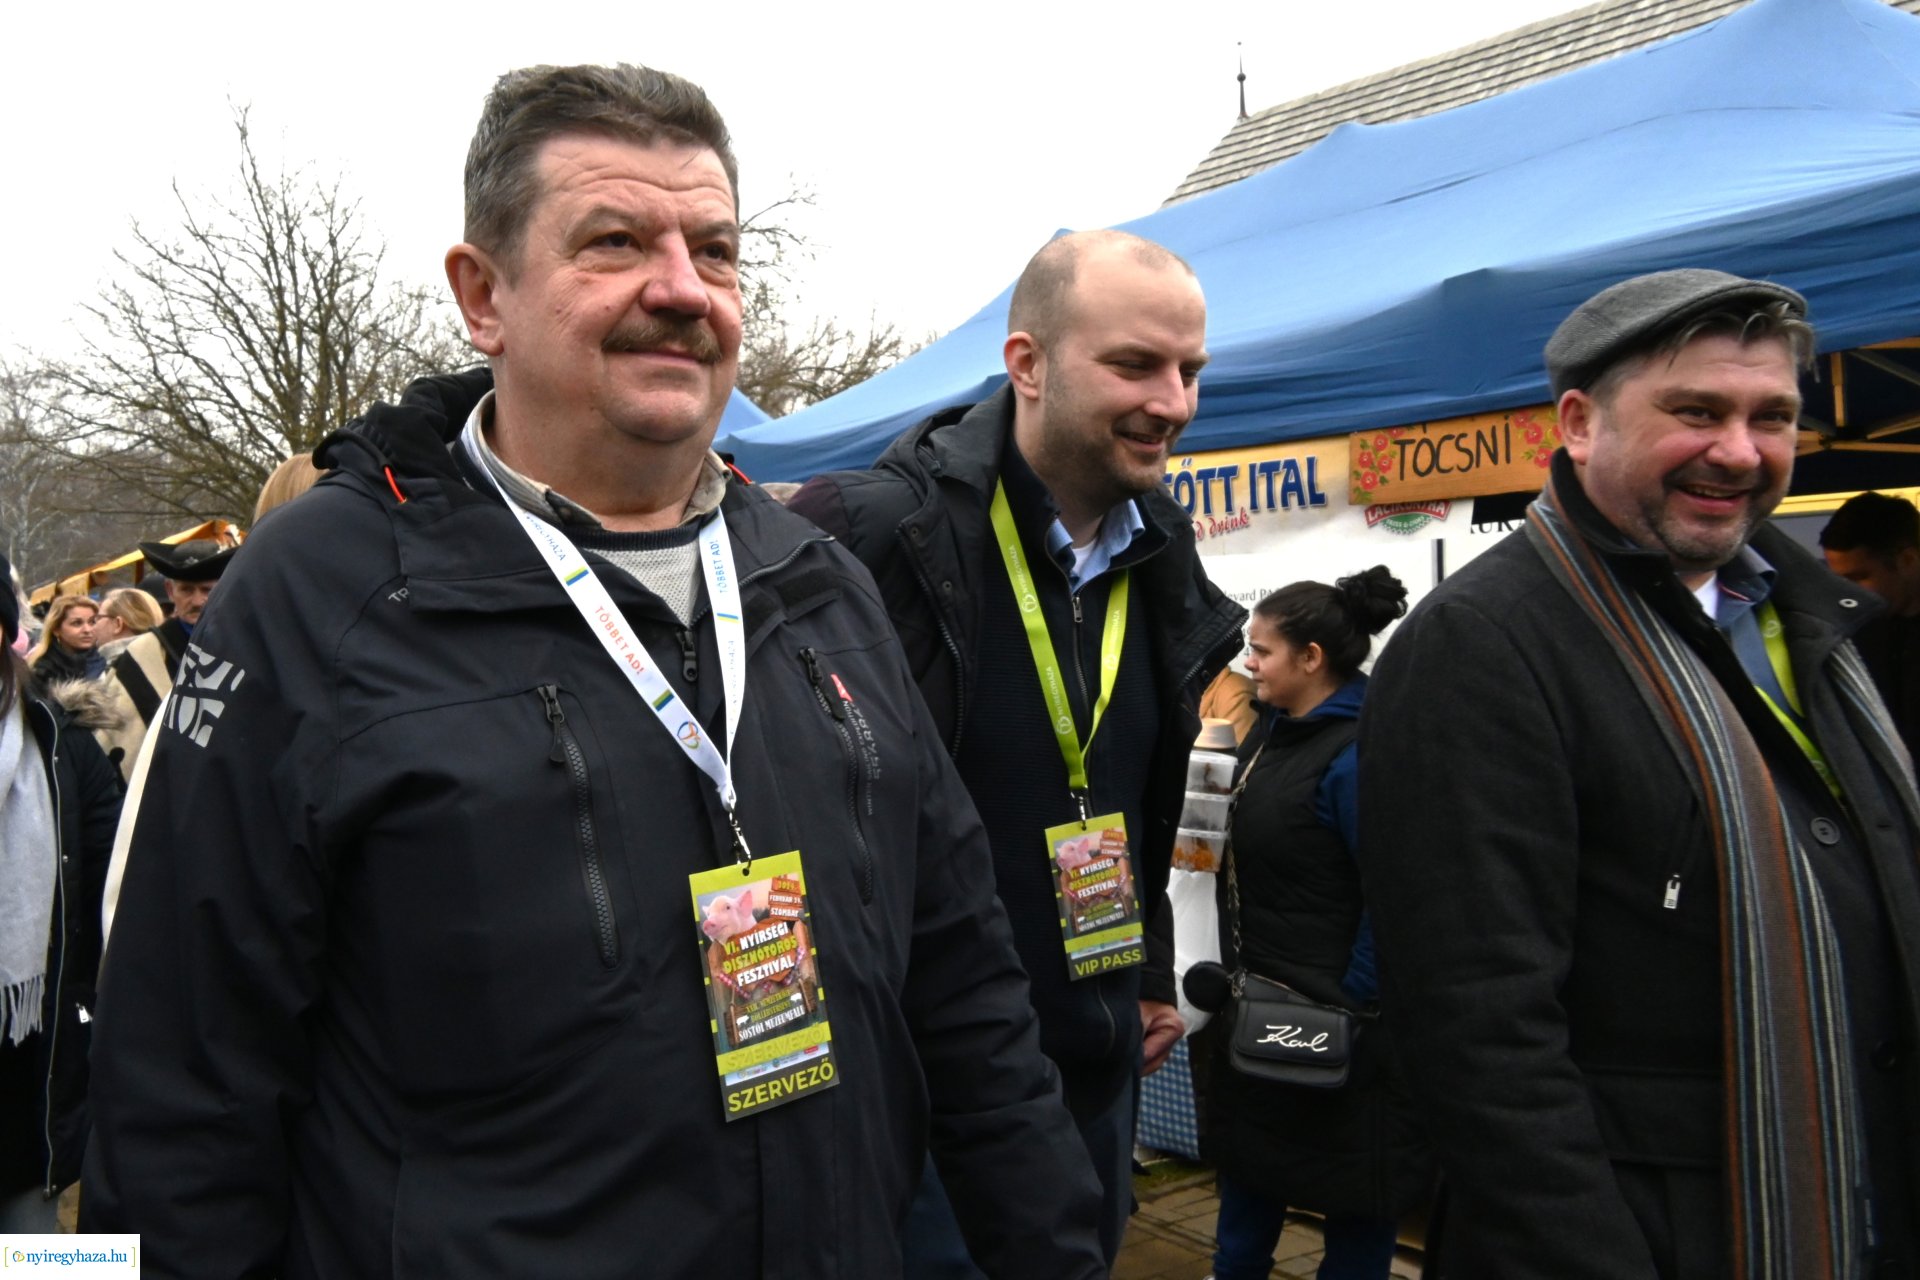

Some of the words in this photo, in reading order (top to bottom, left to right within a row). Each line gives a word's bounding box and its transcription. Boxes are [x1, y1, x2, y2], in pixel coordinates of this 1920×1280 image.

[1249, 456, 1327, 511] ITAL
[1209, 506, 1249, 536] drink
[625, 652, 645, 675] AD!
[724, 941, 740, 955] VI.
[740, 921, 789, 950] NYÍRSÉGI
[723, 935, 798, 974] DISZNÓTOROS
[1075, 958, 1099, 976] VIP
[1102, 949, 1142, 970] PASS
[737, 955, 795, 987] FESZTIVÁL
[1256, 1024, 1329, 1052] Karl
[728, 1057, 834, 1112] SZERVEZŐ
